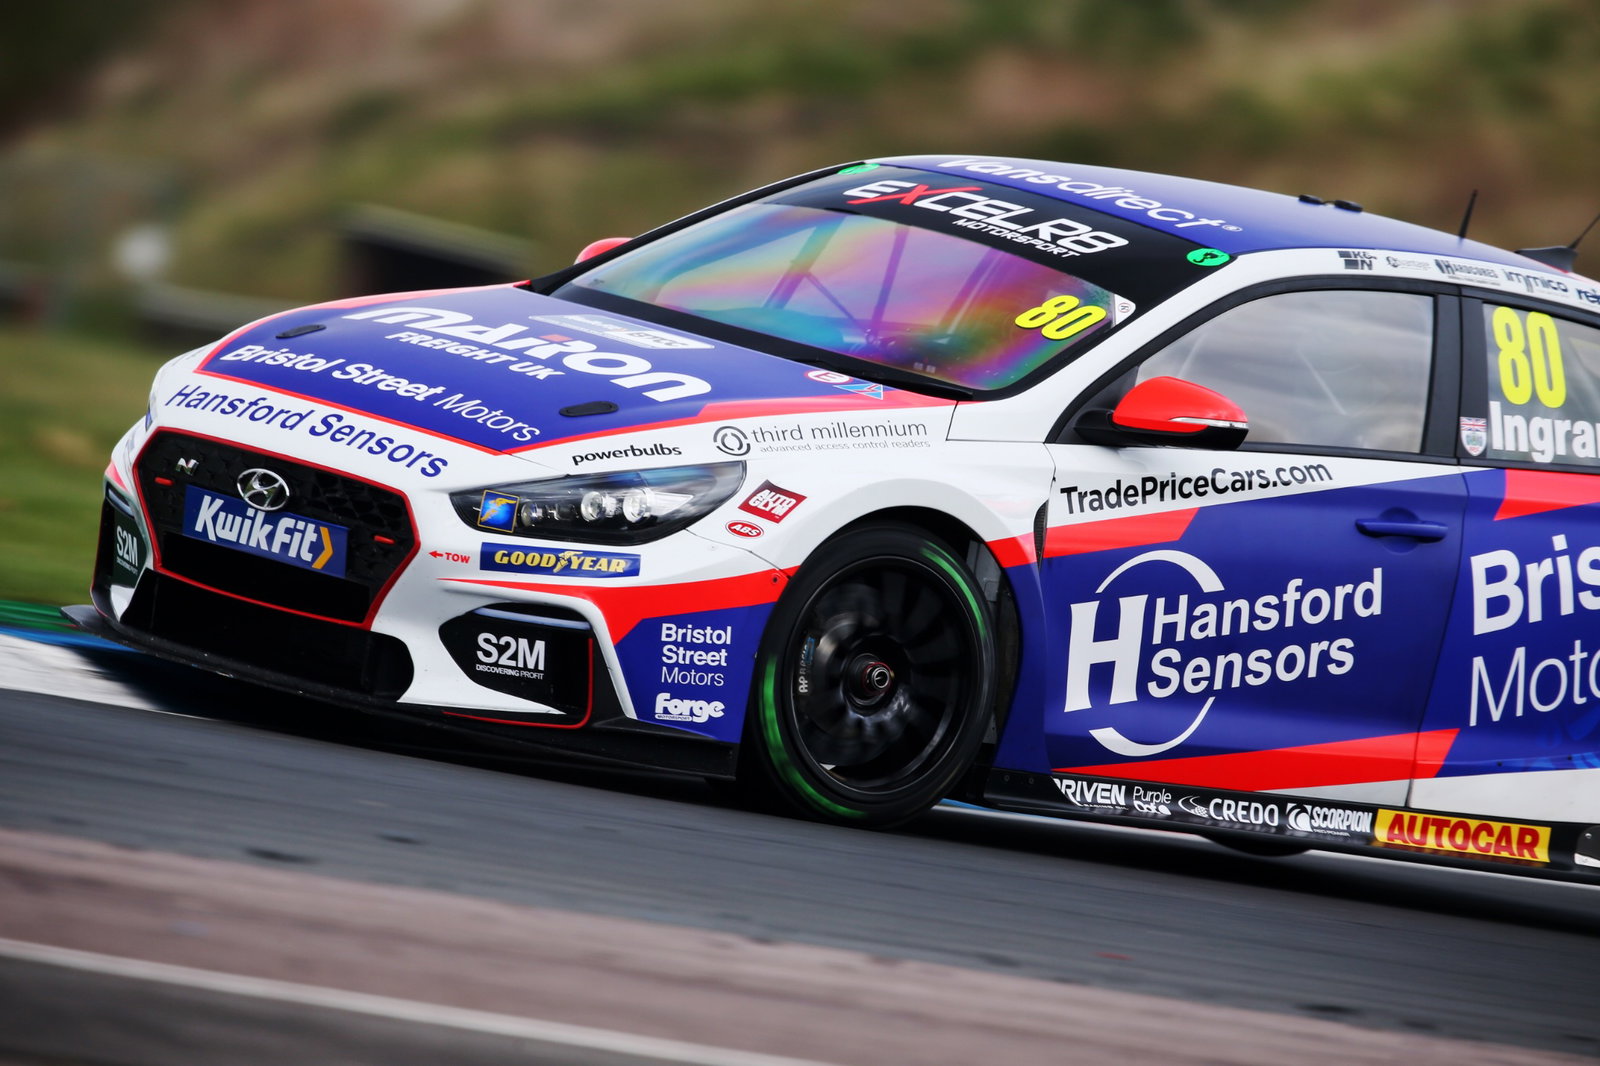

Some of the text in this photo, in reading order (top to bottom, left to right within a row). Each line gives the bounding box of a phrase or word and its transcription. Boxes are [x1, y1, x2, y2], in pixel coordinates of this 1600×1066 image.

[842, 180, 1129, 254] EXCELR8
[951, 219, 1080, 258] MOTORSPORT
[1014, 295, 1107, 341] 80
[385, 331, 566, 380] FREIGHT UK
[1492, 306, 1567, 409] 80
[219, 345, 541, 442] Bristol Street Motors
[164, 384, 448, 477] Hansford Sensors
[751, 420, 928, 443] third millennium
[759, 438, 931, 454] advanced access control readers
[1489, 400, 1600, 463] Ingra
[571, 443, 682, 466] powerbulbs
[1059, 463, 1333, 515] TradePriceCars.com
[116, 525, 139, 567] S2M
[445, 552, 471, 564] TOW
[1152, 567, 1383, 645] Hansford
[476, 632, 546, 671] S2M
[661, 623, 732, 645] Bristol
[475, 663, 545, 680] DISCOVERING PROFIT
[661, 644, 728, 667] Street
[1147, 637, 1355, 698] Sensors
[661, 666, 725, 686] Motors
[655, 692, 725, 723] Forge
[1133, 786, 1172, 804] Purple
[1209, 798, 1279, 827] CREDO
[1312, 806, 1373, 833] SCORPION
[1387, 813, 1540, 860] AUTOCAR
